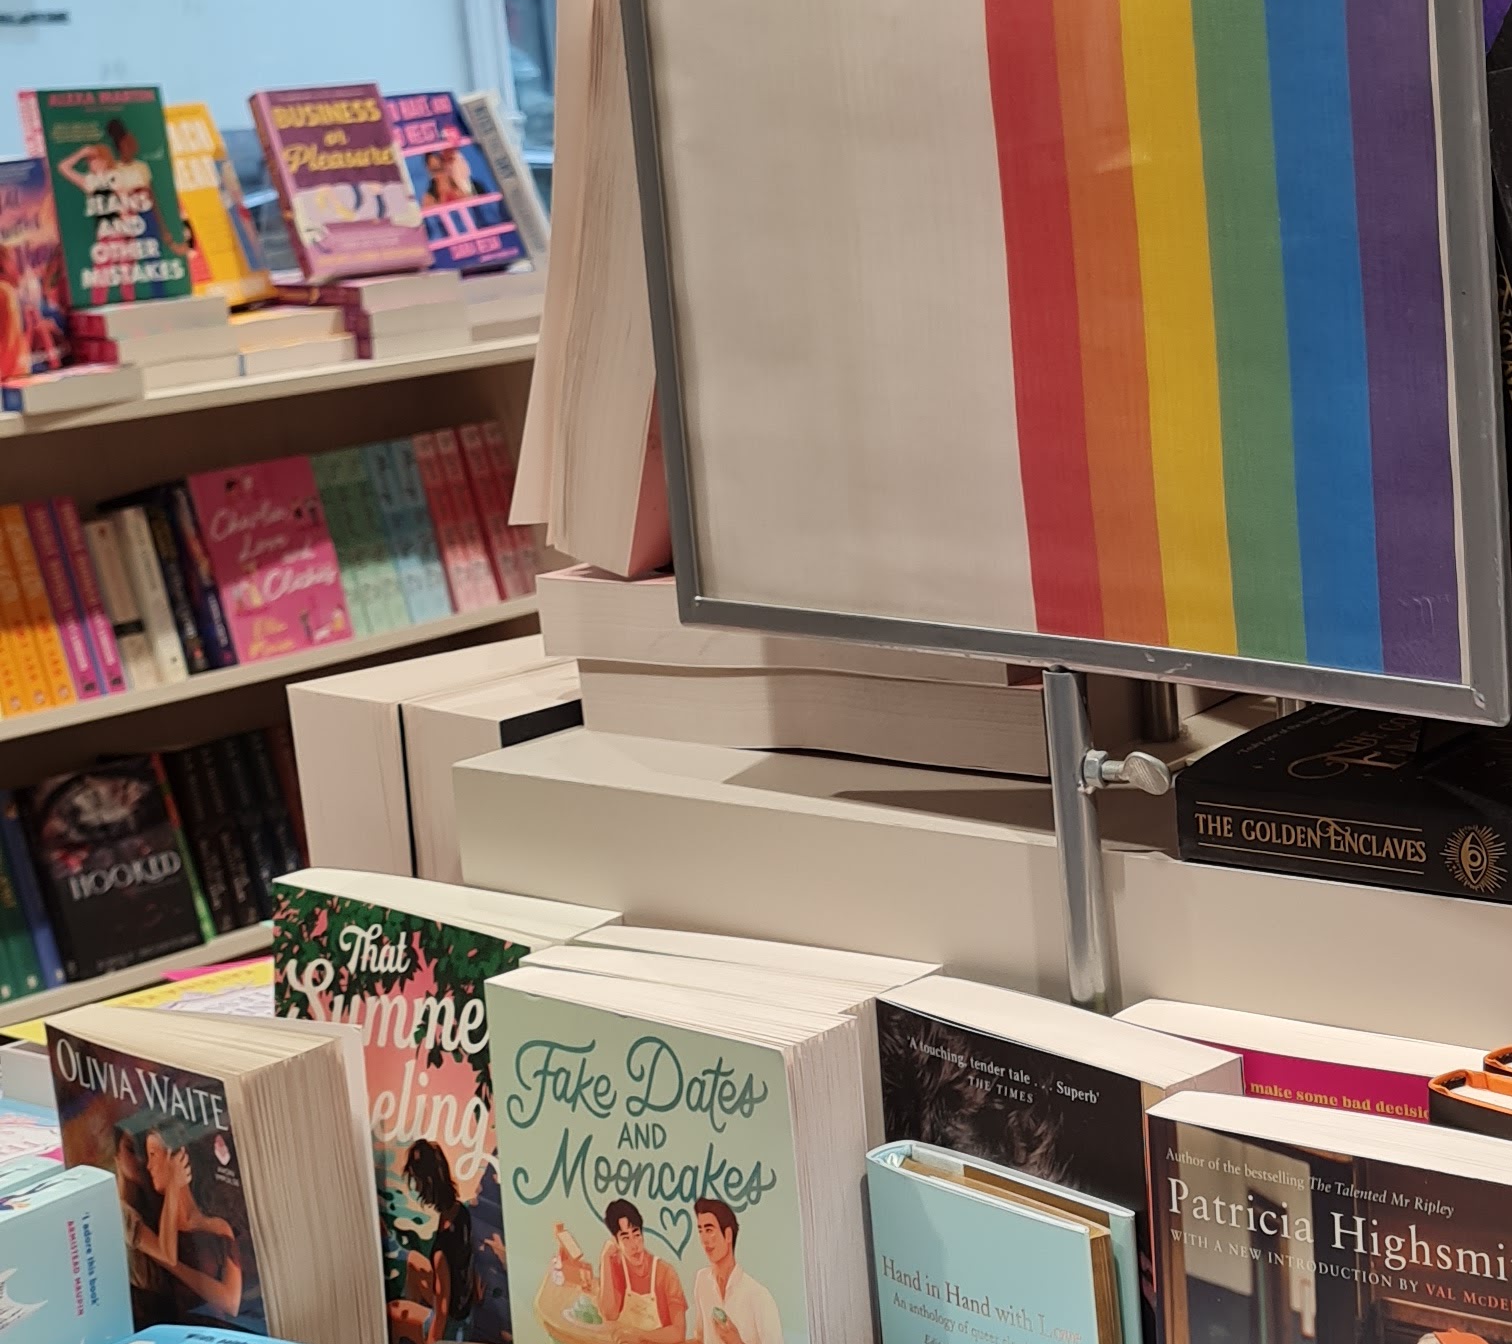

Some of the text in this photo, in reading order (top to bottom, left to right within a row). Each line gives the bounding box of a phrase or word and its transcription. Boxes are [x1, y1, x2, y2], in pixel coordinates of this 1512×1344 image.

[271, 97, 383, 129] BUSINESS
[81, 258, 185, 290] MISTAKES
[1195, 813, 1235, 840] THE
[1241, 820, 1322, 849] GOLDEN
[1316, 818, 1428, 864] ENCLAVES
[69, 851, 181, 902] HOOKED
[340, 923, 411, 974] That
[55, 1037, 229, 1132] OLIVIA WAITE
[506, 1035, 768, 1134] Fake Dates
[919, 1042, 968, 1068] touching,
[970, 1057, 1005, 1077] tender
[1008, 1067, 1031, 1085] tale
[1056, 1080, 1100, 1104] Superb'
[617, 1121, 667, 1151] AND
[512, 1128, 777, 1214] Mooncakes
[1168, 1177, 1315, 1245] Patricia
[881, 1255, 922, 1292] Hand
[925, 1274, 941, 1299] in
[946, 1281, 991, 1317] Hand
[995, 1305, 1034, 1333] with
